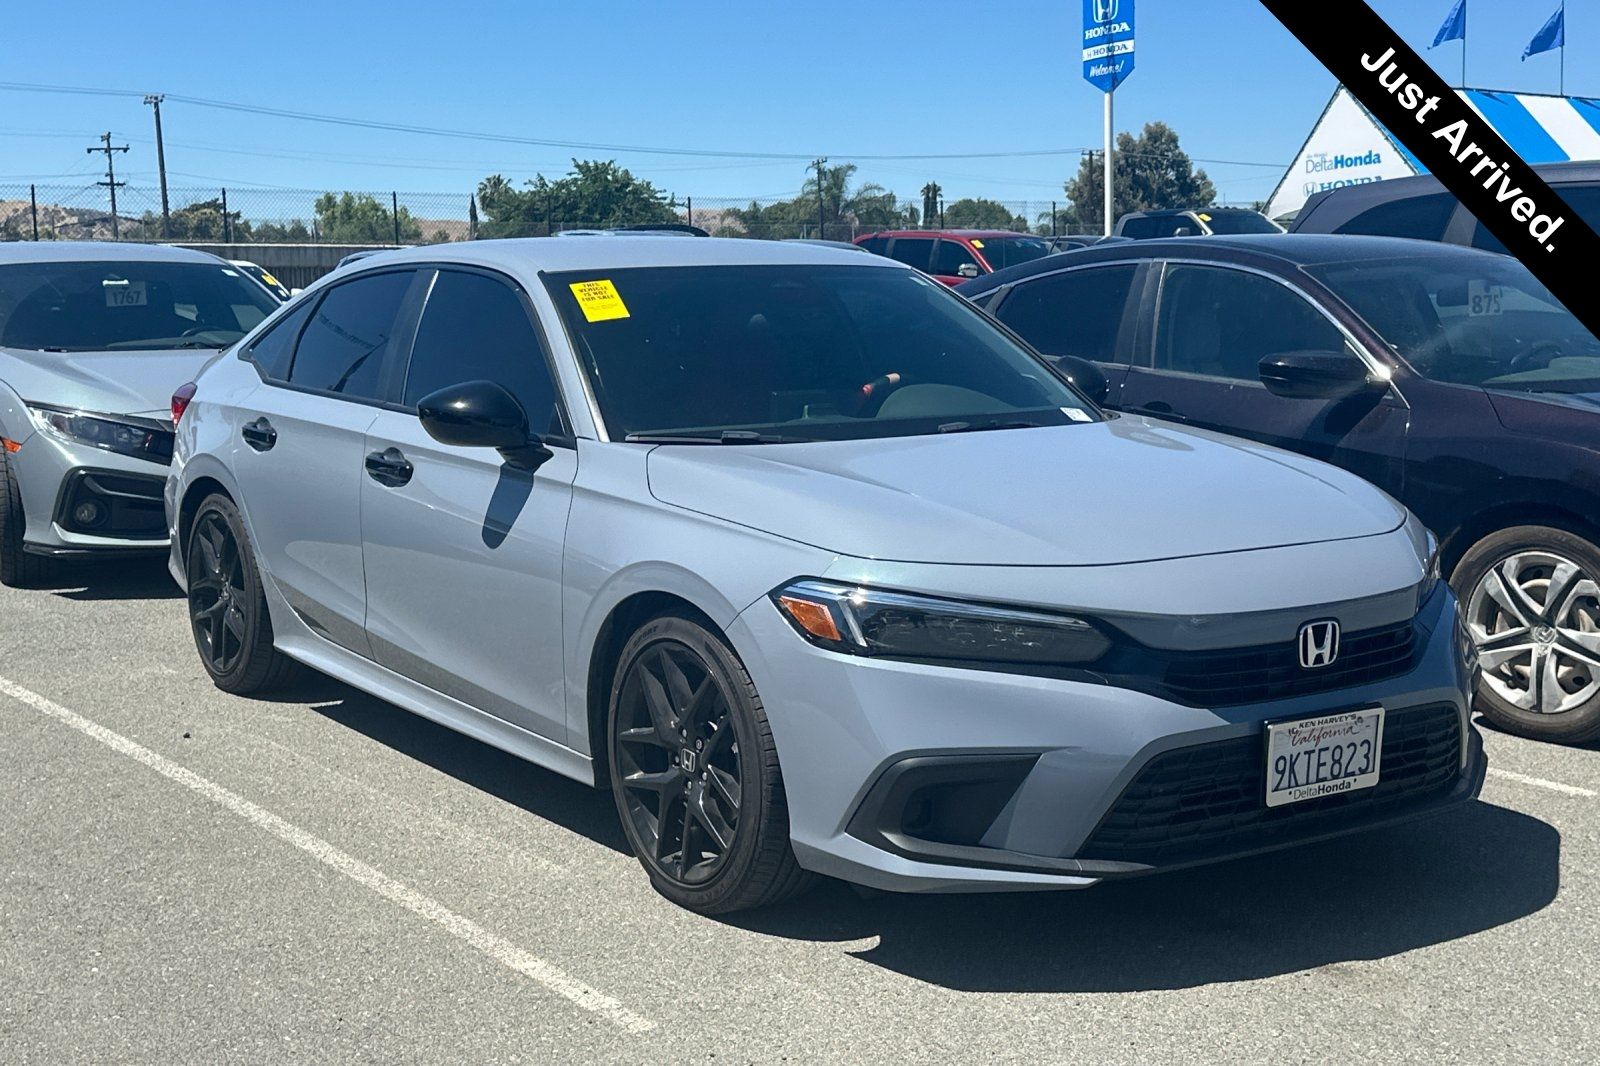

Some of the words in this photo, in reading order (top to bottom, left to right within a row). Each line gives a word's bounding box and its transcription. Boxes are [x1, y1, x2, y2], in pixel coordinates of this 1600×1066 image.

[1085, 22, 1131, 40] HONDA
[1092, 43, 1128, 56] HONDA
[1089, 59, 1125, 77] Welcome!
[1305, 150, 1382, 174] DeltaHonda
[112, 290, 141, 305] 1767
[1471, 294, 1501, 314] 875
[1298, 720, 1316, 729] KEN
[1317, 713, 1357, 725] HARVEY'S
[1291, 725, 1360, 747] California
[1274, 738, 1372, 791] 9KTE823
[1293, 780, 1352, 800] DeltaHonda
